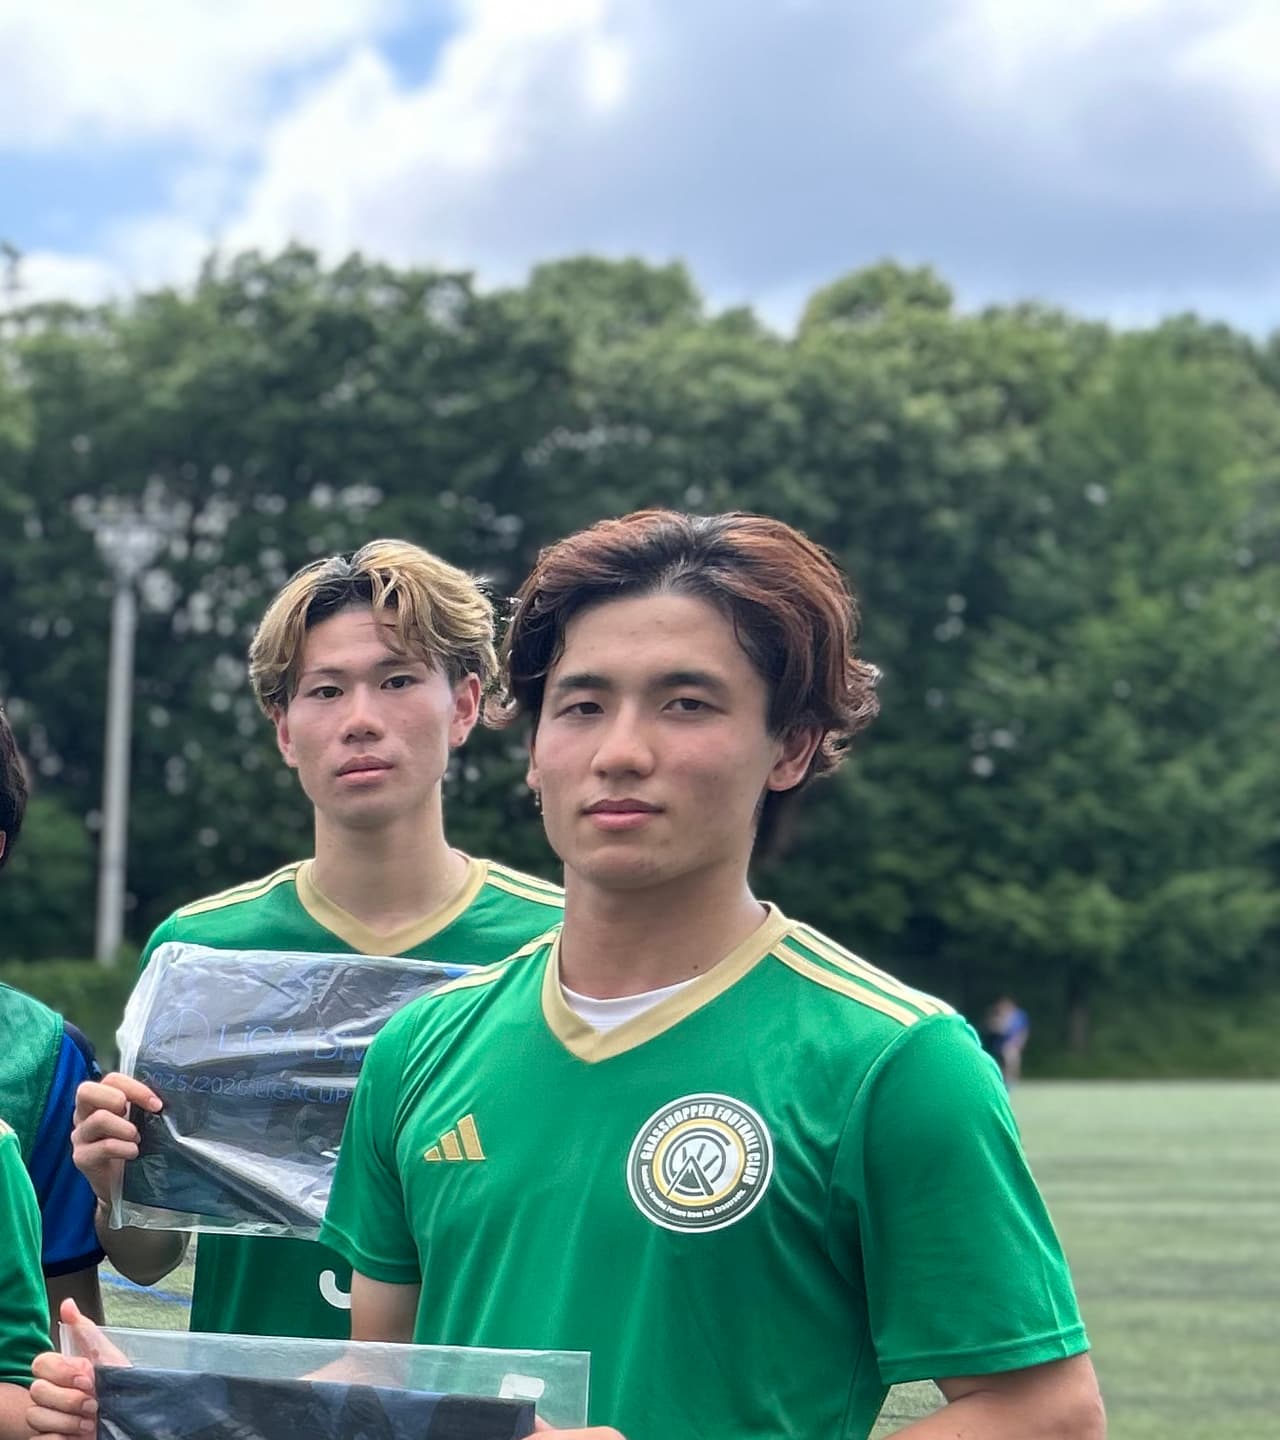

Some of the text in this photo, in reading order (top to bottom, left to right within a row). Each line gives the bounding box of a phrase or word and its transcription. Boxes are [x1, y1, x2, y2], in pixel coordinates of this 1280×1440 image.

[640, 1104, 760, 1185] GRASSHOPPER FOOTBALL CLUB
